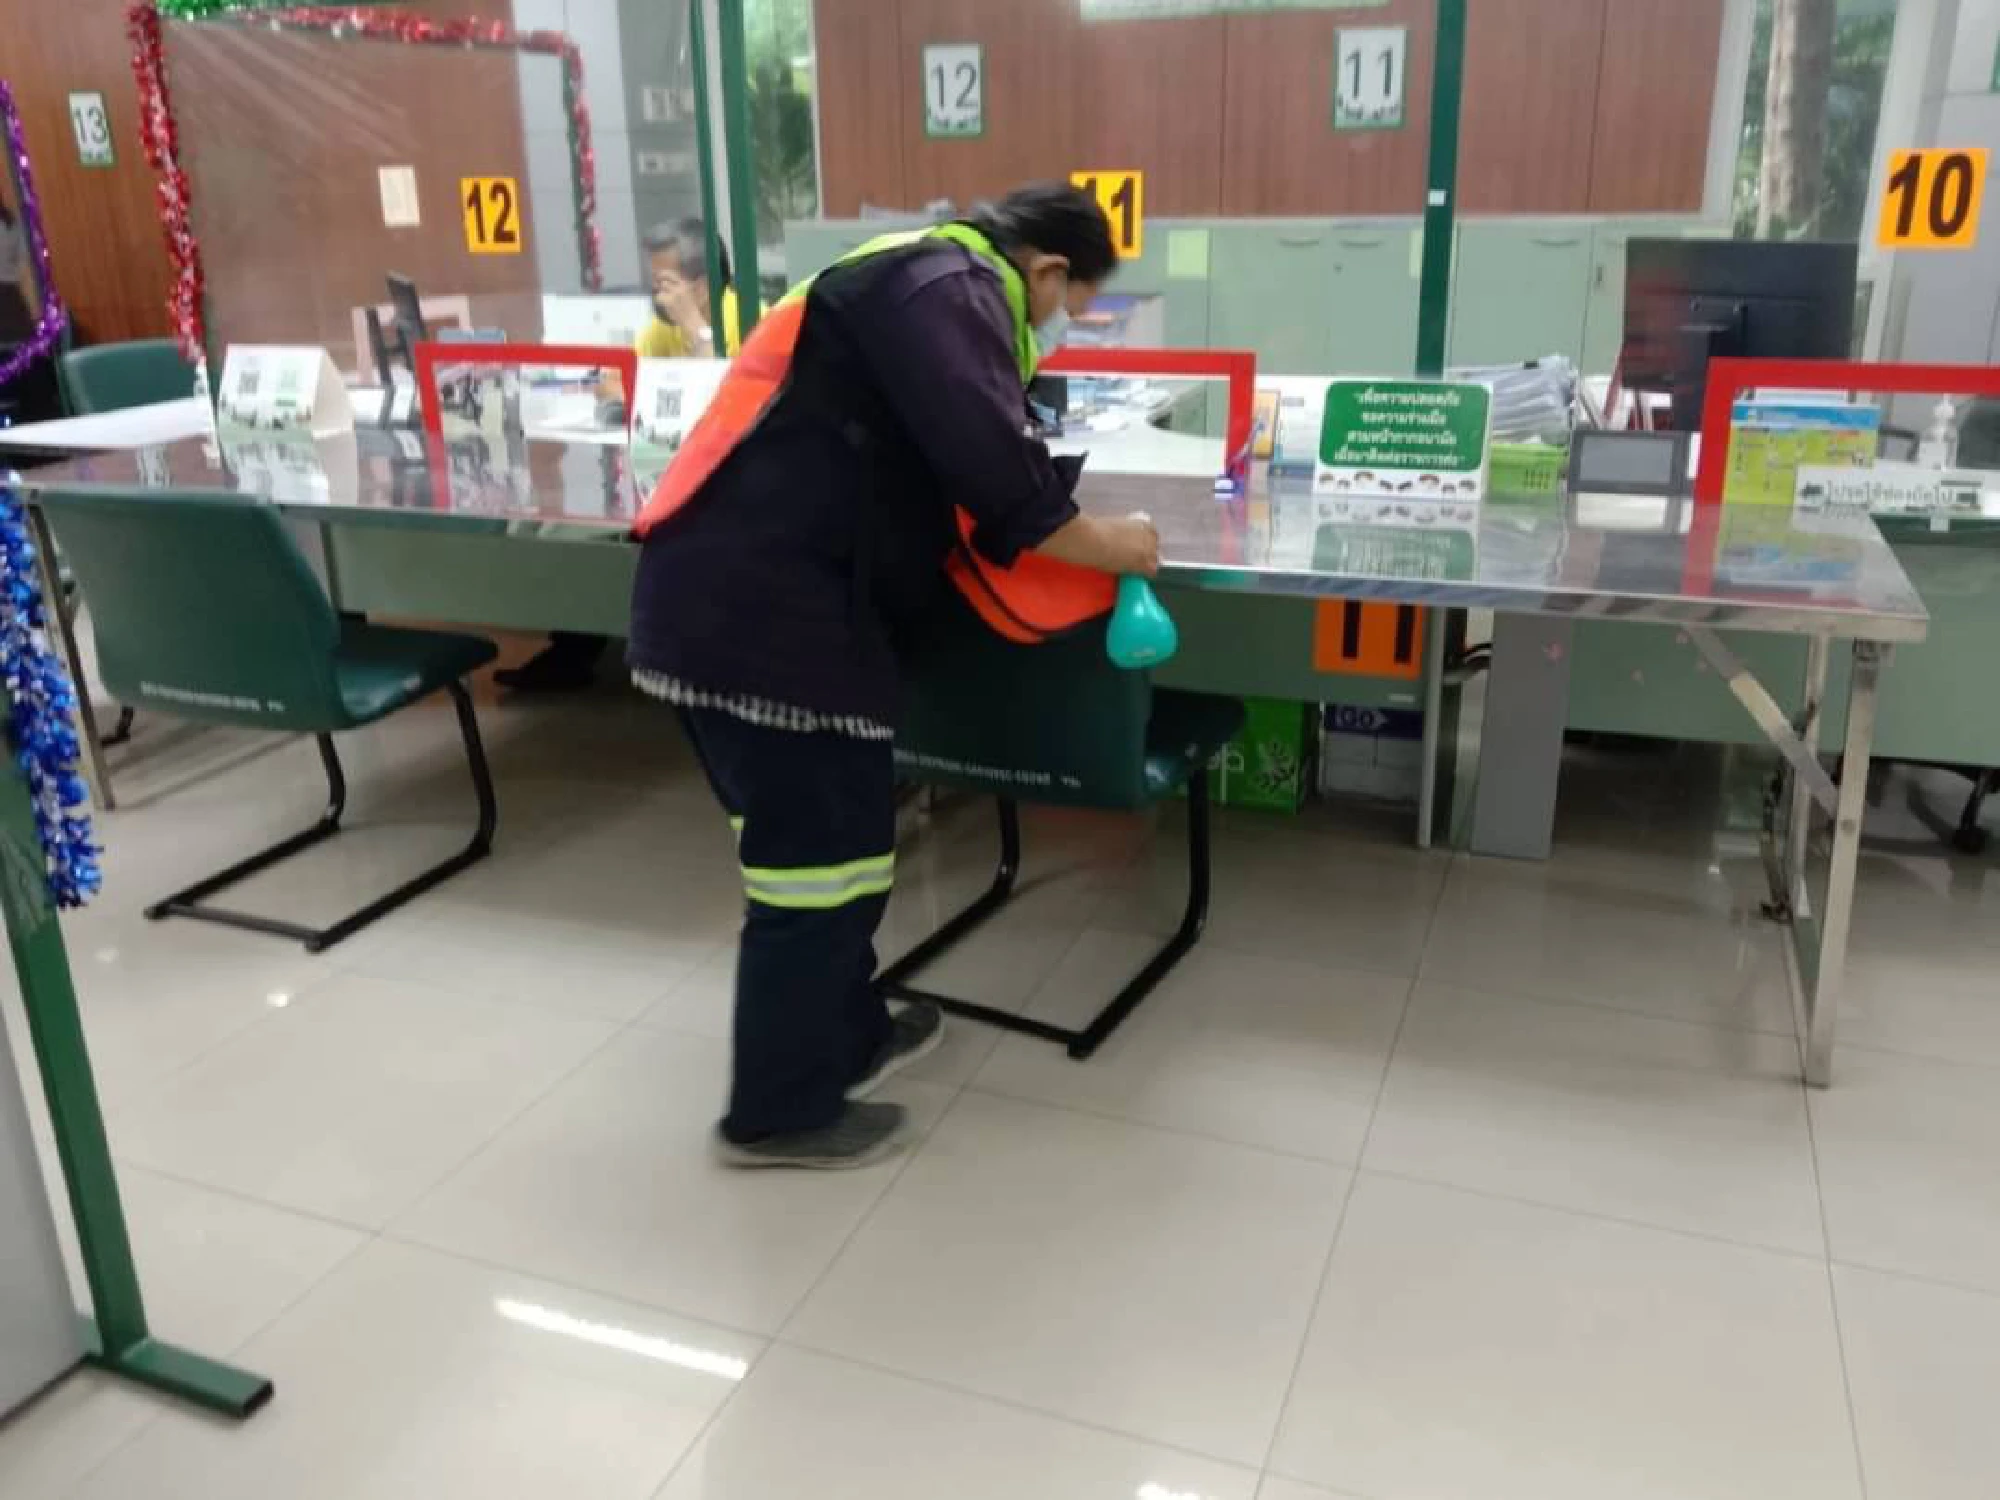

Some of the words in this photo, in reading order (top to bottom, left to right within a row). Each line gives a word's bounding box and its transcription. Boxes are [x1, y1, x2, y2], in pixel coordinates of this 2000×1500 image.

[931, 61, 978, 109] 12
[1344, 47, 1394, 100] 11
[74, 106, 107, 144] 13
[467, 181, 516, 244] 12
[1887, 152, 1974, 238] 10
